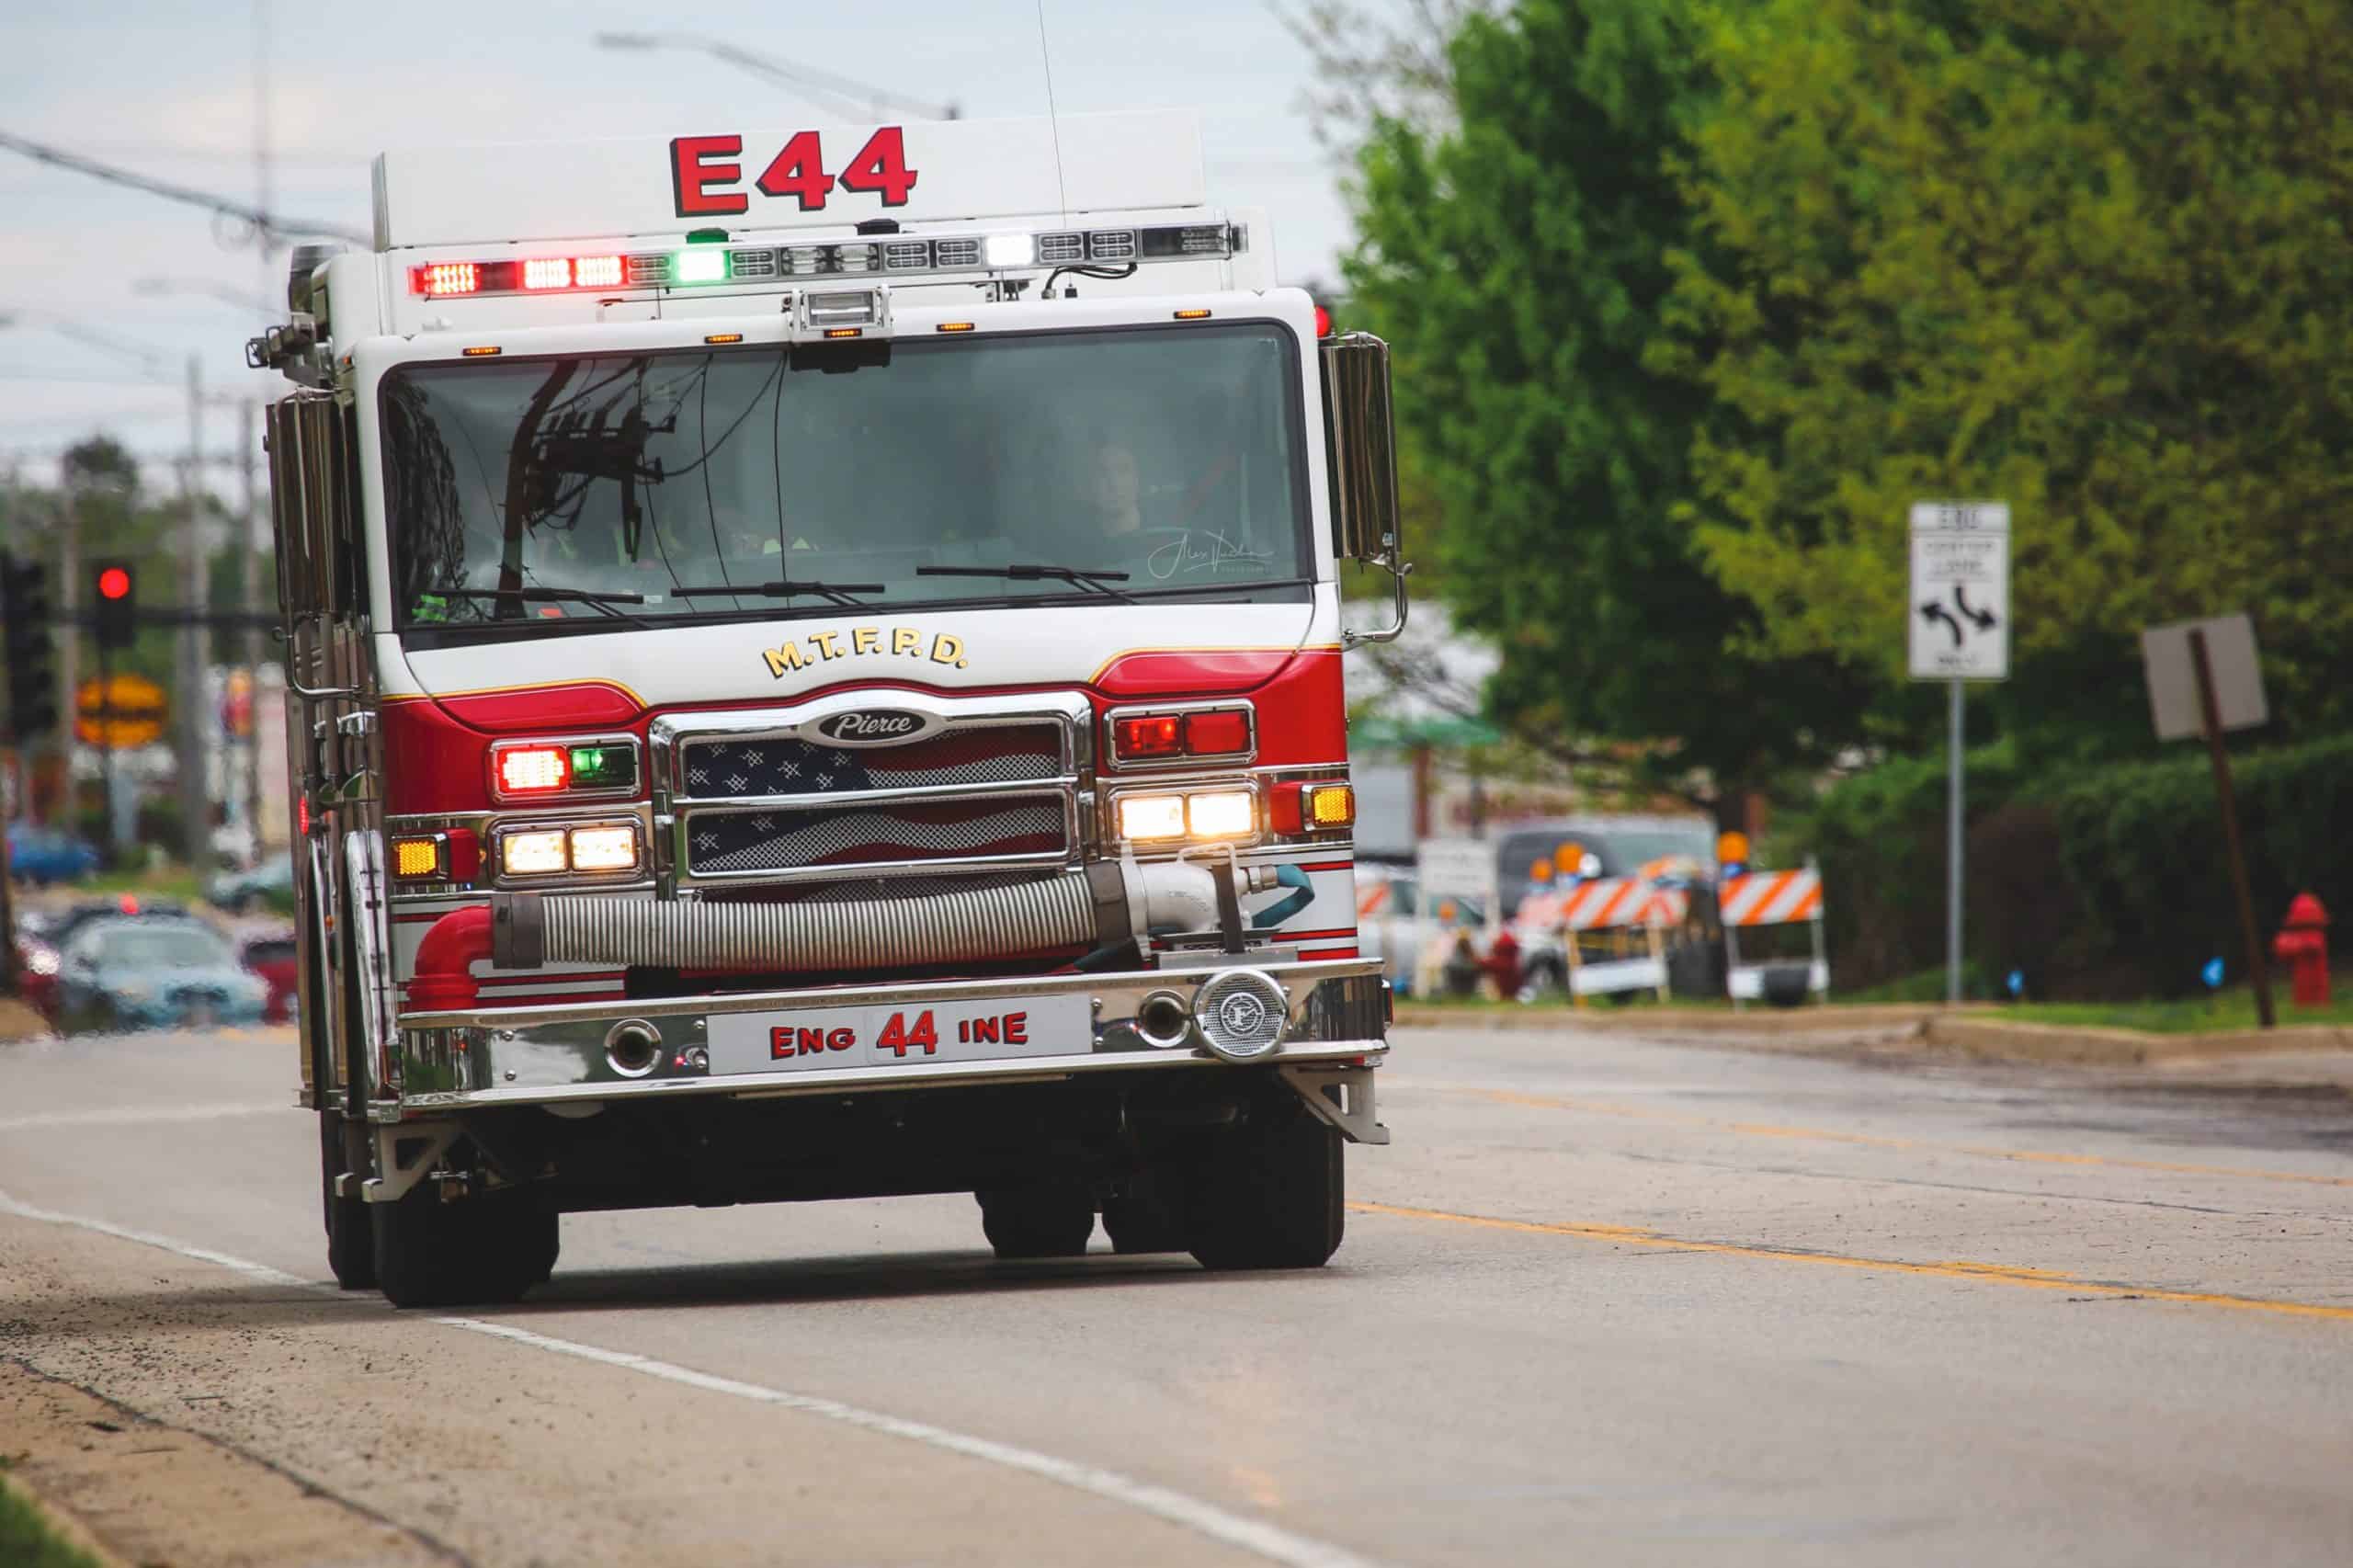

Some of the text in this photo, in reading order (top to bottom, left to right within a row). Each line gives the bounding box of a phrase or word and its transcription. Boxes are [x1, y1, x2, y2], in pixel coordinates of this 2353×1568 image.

[670, 126, 918, 219] E44
[834, 713, 913, 739] Pierce
[770, 1010, 1029, 1060] ENG 44 INE
